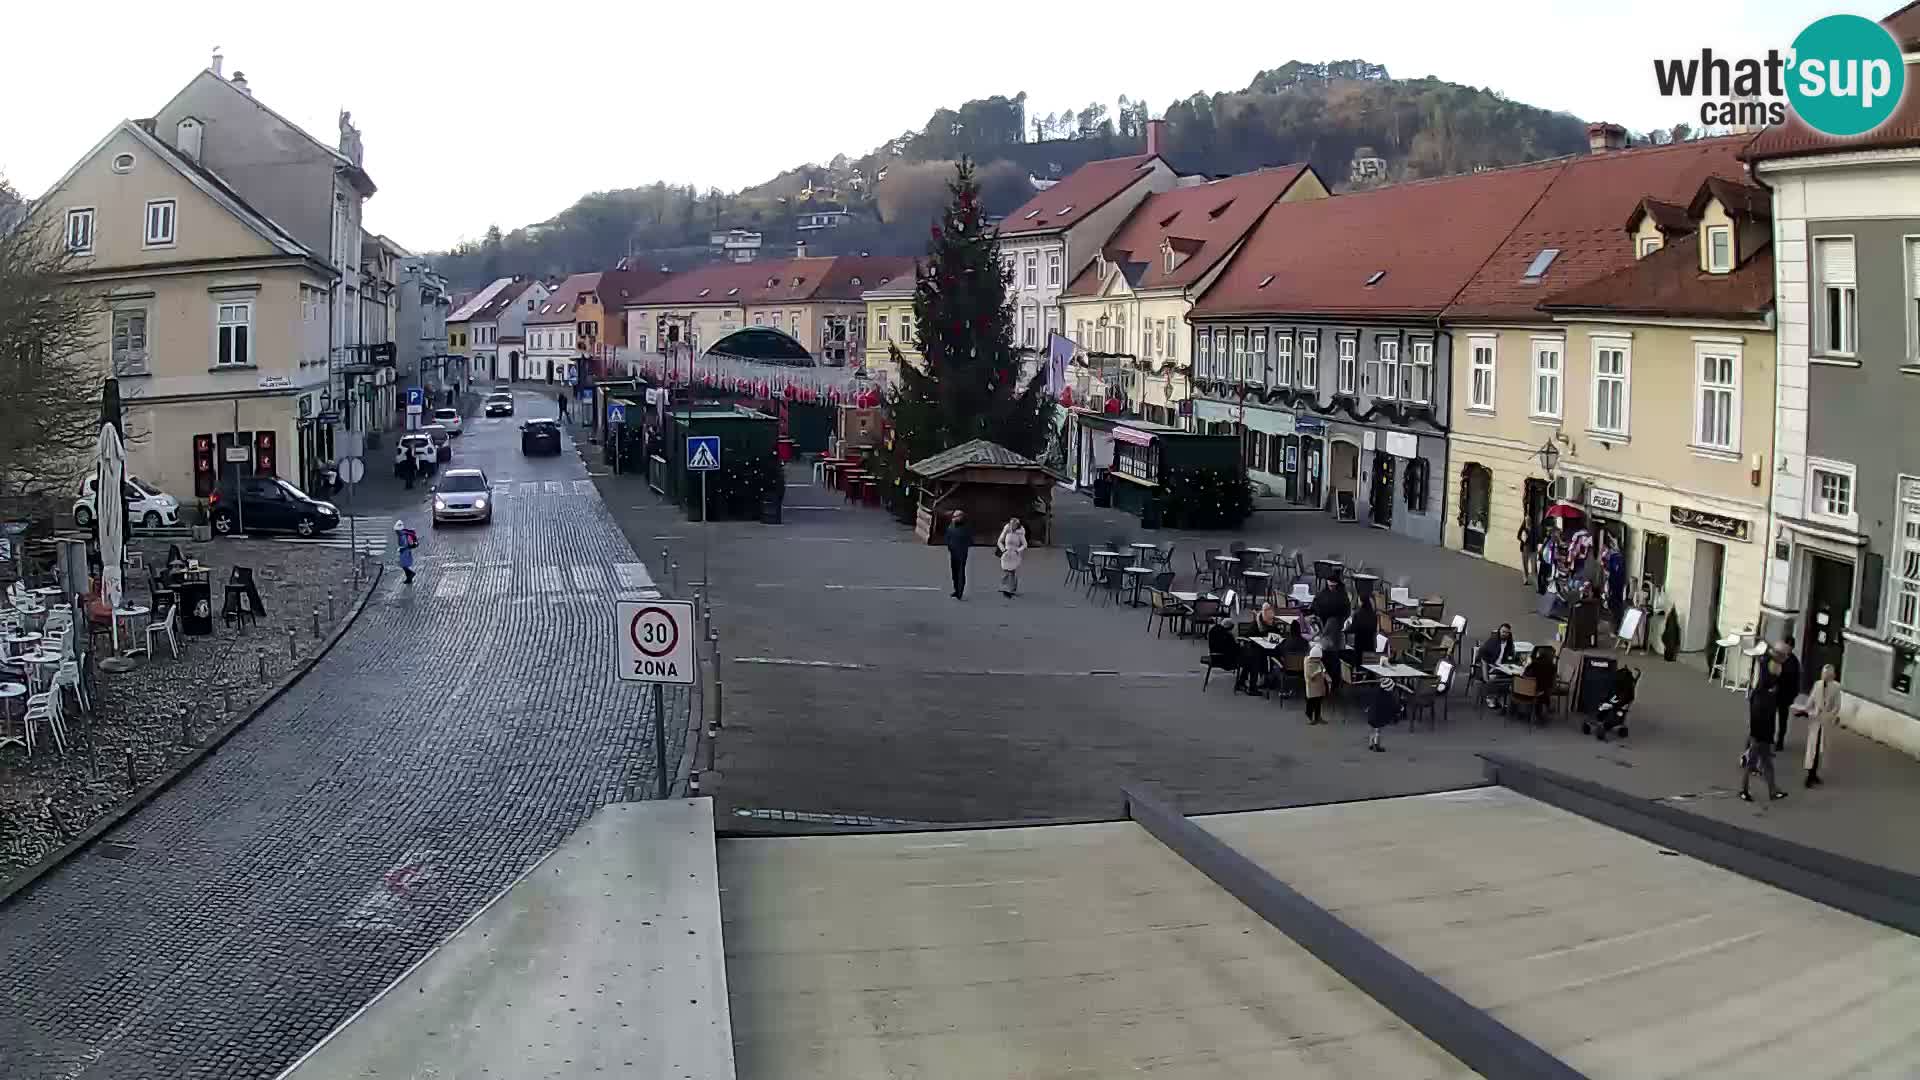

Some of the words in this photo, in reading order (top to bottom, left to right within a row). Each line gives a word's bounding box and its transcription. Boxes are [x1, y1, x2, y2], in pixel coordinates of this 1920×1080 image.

[410, 391, 418, 403] P
[643, 622, 667, 643] 30
[634, 659, 678, 676] ZONA
